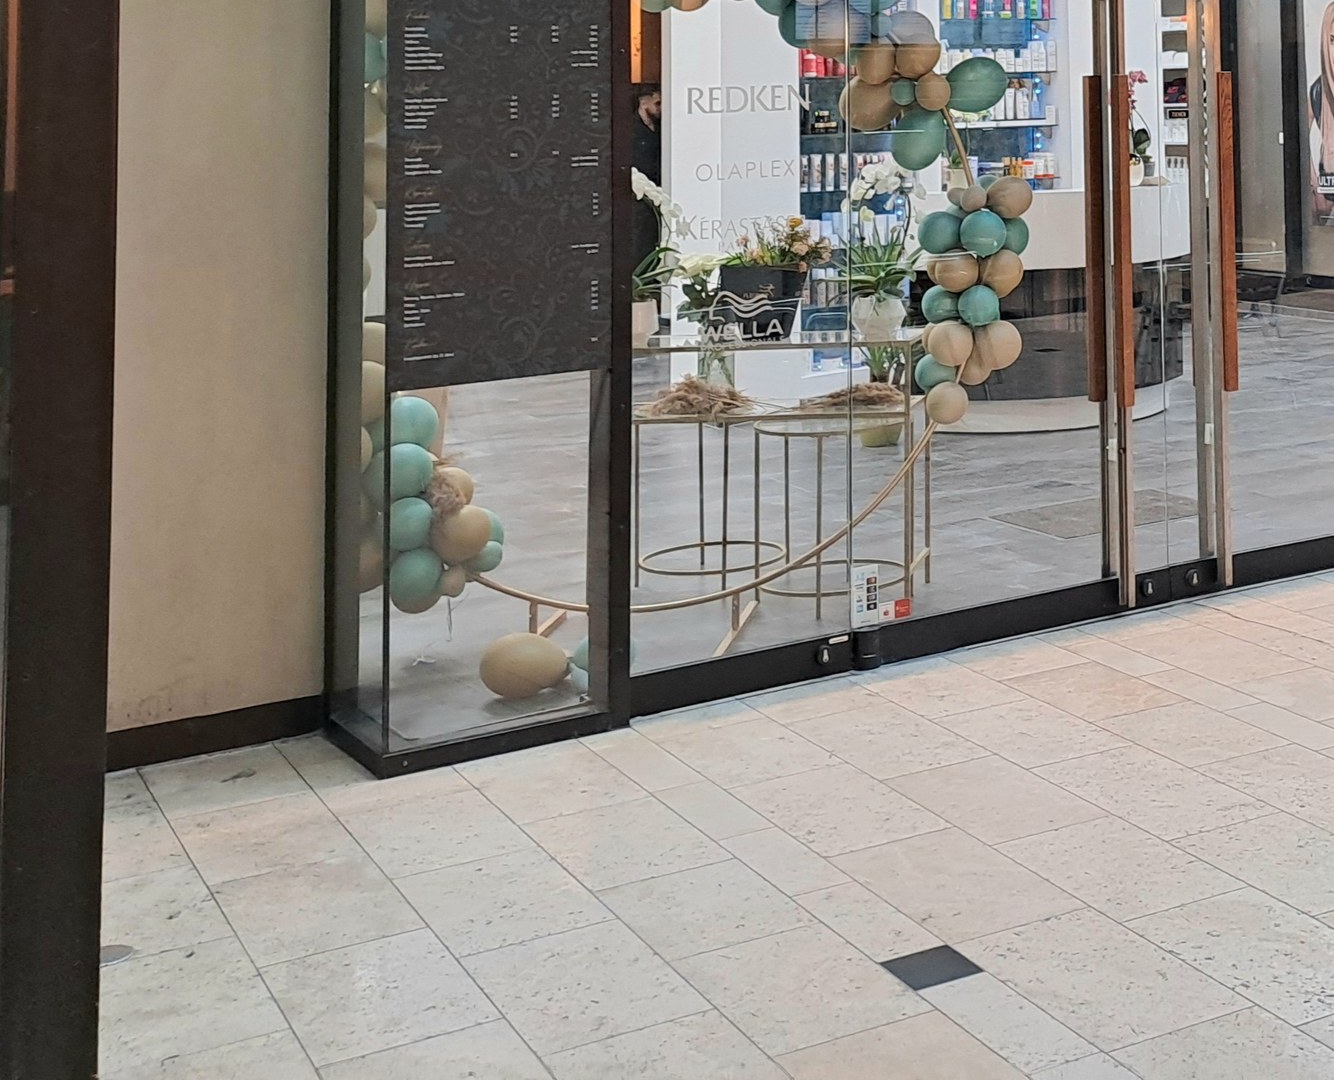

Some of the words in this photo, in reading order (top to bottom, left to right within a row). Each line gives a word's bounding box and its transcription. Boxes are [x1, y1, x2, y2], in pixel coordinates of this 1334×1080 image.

[686, 83, 812, 115] REDKEN
[695, 159, 795, 182] OLAPLEX
[700, 318, 785, 342] WELLA
